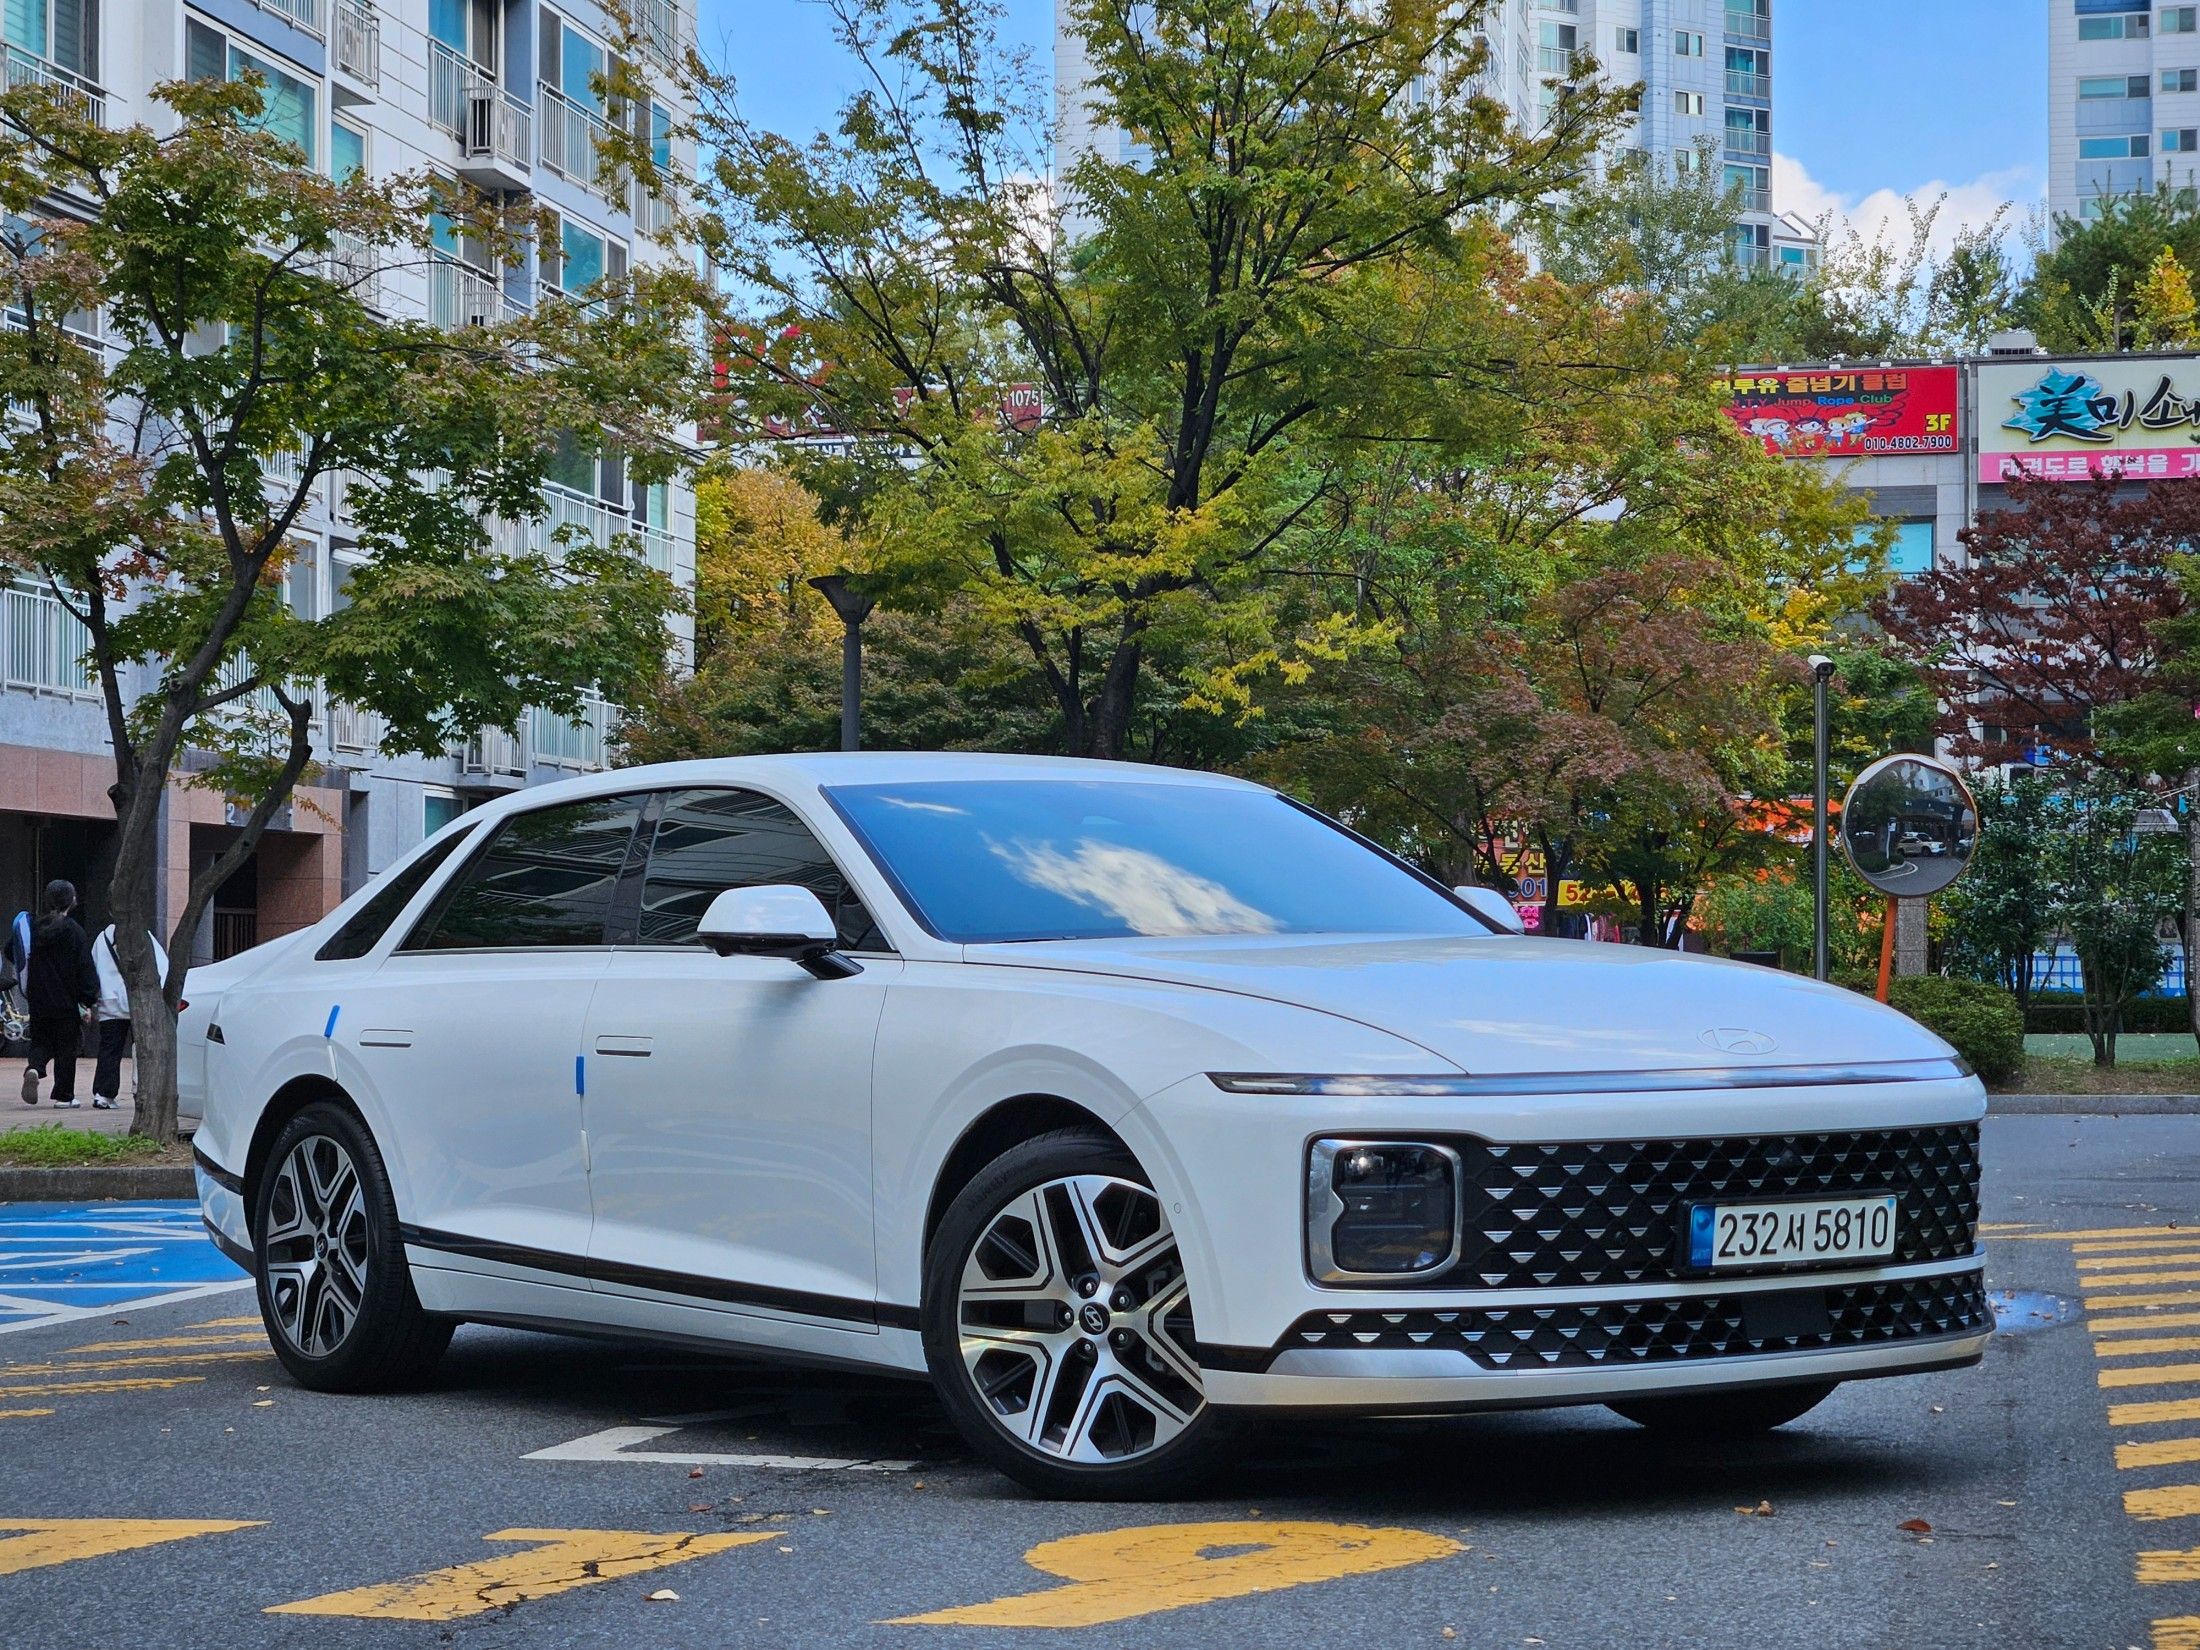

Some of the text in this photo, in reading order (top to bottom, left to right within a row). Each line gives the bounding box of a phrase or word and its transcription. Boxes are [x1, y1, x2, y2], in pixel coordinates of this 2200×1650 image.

[1786, 374, 1856, 394] 줄넘기
[1861, 373, 1907, 391] 클럽
[1775, 397, 1812, 408] Jump
[1817, 396, 1855, 407] Rope
[1860, 394, 1893, 404] Club
[1925, 413, 1951, 432] 3F
[1865, 434, 1953, 451] 010.4802.7900
[2101, 454, 2168, 475] 행복을
[1718, 1206, 1889, 1258] 232서 5810
